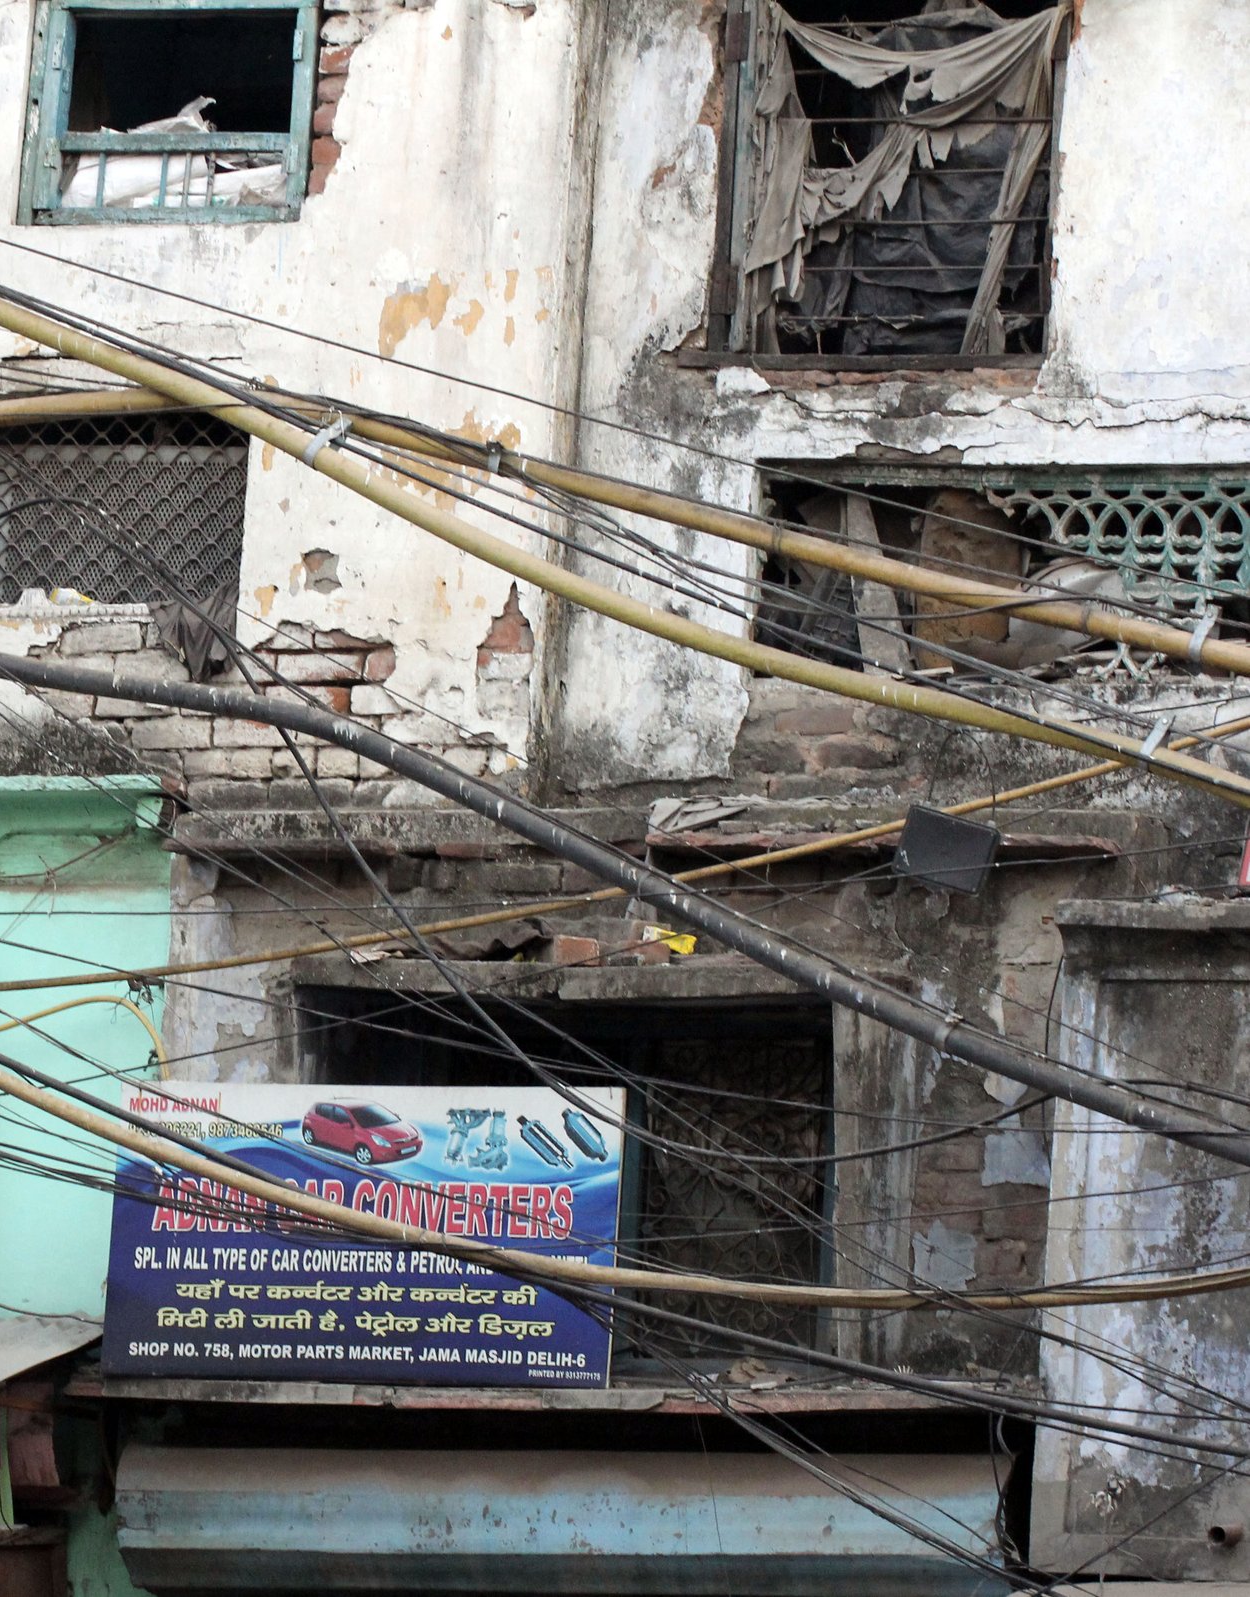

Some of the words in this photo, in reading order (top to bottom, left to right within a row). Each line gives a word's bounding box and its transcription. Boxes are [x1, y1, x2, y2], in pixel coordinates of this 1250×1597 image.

[129, 1097, 168, 1113] MOHD
[172, 1098, 218, 1114] ADNAN
[353, 1178, 574, 1240] CONVERTERS
[134, 1247, 162, 1270] SPL.
[166, 1247, 181, 1270] IN
[183, 1248, 209, 1271] ALL
[213, 1248, 247, 1271] TYPE
[250, 1249, 268, 1272] OF
[271, 1249, 300, 1272] CAR
[302, 1249, 392, 1274] CONVERTERS
[396, 1253, 406, 1274] &
[228, 1284, 262, 1300] पर
[356, 1281, 405, 1302] और
[502, 1285, 538, 1306] की
[156, 1306, 209, 1329] मिटी
[214, 1307, 246, 1329] ली
[251, 1308, 313, 1331] जाती
[354, 1310, 421, 1337] पेट्रोल
[424, 1312, 474, 1334] और
[128, 1341, 170, 1357] SHOP
[173, 1342, 199, 1358] NO.
[203, 1343, 235, 1360] 758,
[238, 1343, 293, 1359] MOTOR
[296, 1345, 345, 1360] PARTS
[348, 1345, 415, 1365] MARKET,
[418, 1347, 461, 1363] JAMA
[465, 1348, 523, 1365] MASJID
[527, 1350, 587, 1368] DELIH-6
[528, 1369, 554, 1379] PRINTED
[555, 1371, 564, 1379] BY
